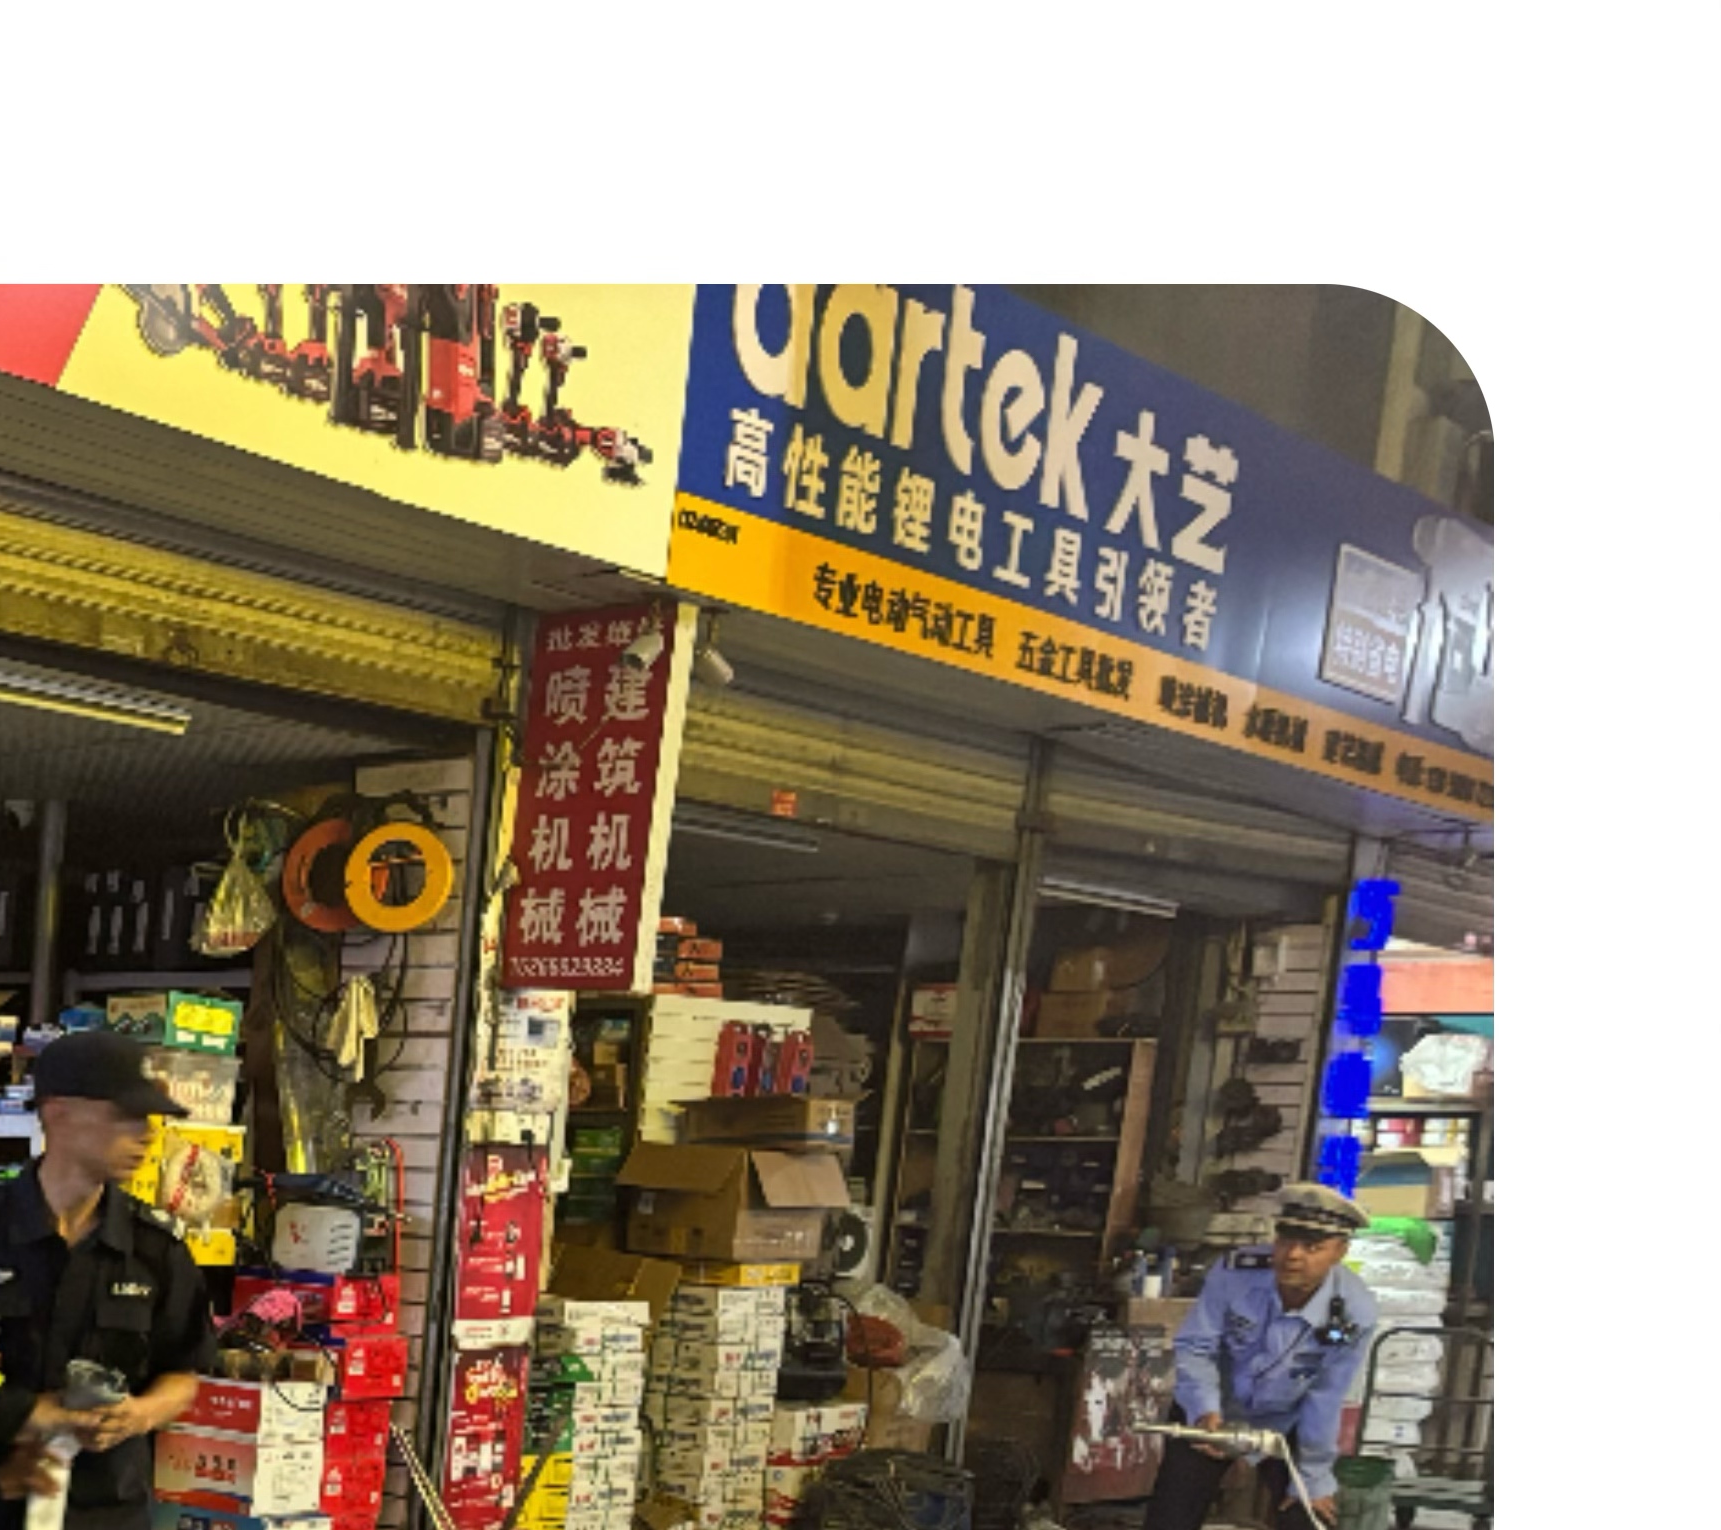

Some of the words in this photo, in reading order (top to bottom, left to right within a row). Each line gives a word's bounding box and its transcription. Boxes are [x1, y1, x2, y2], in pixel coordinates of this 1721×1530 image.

[725, 406, 1218, 652] 高性能锂电工具引领者
[1104, 407, 1240, 575] 大艺
[546, 617, 663, 653] 批发维
